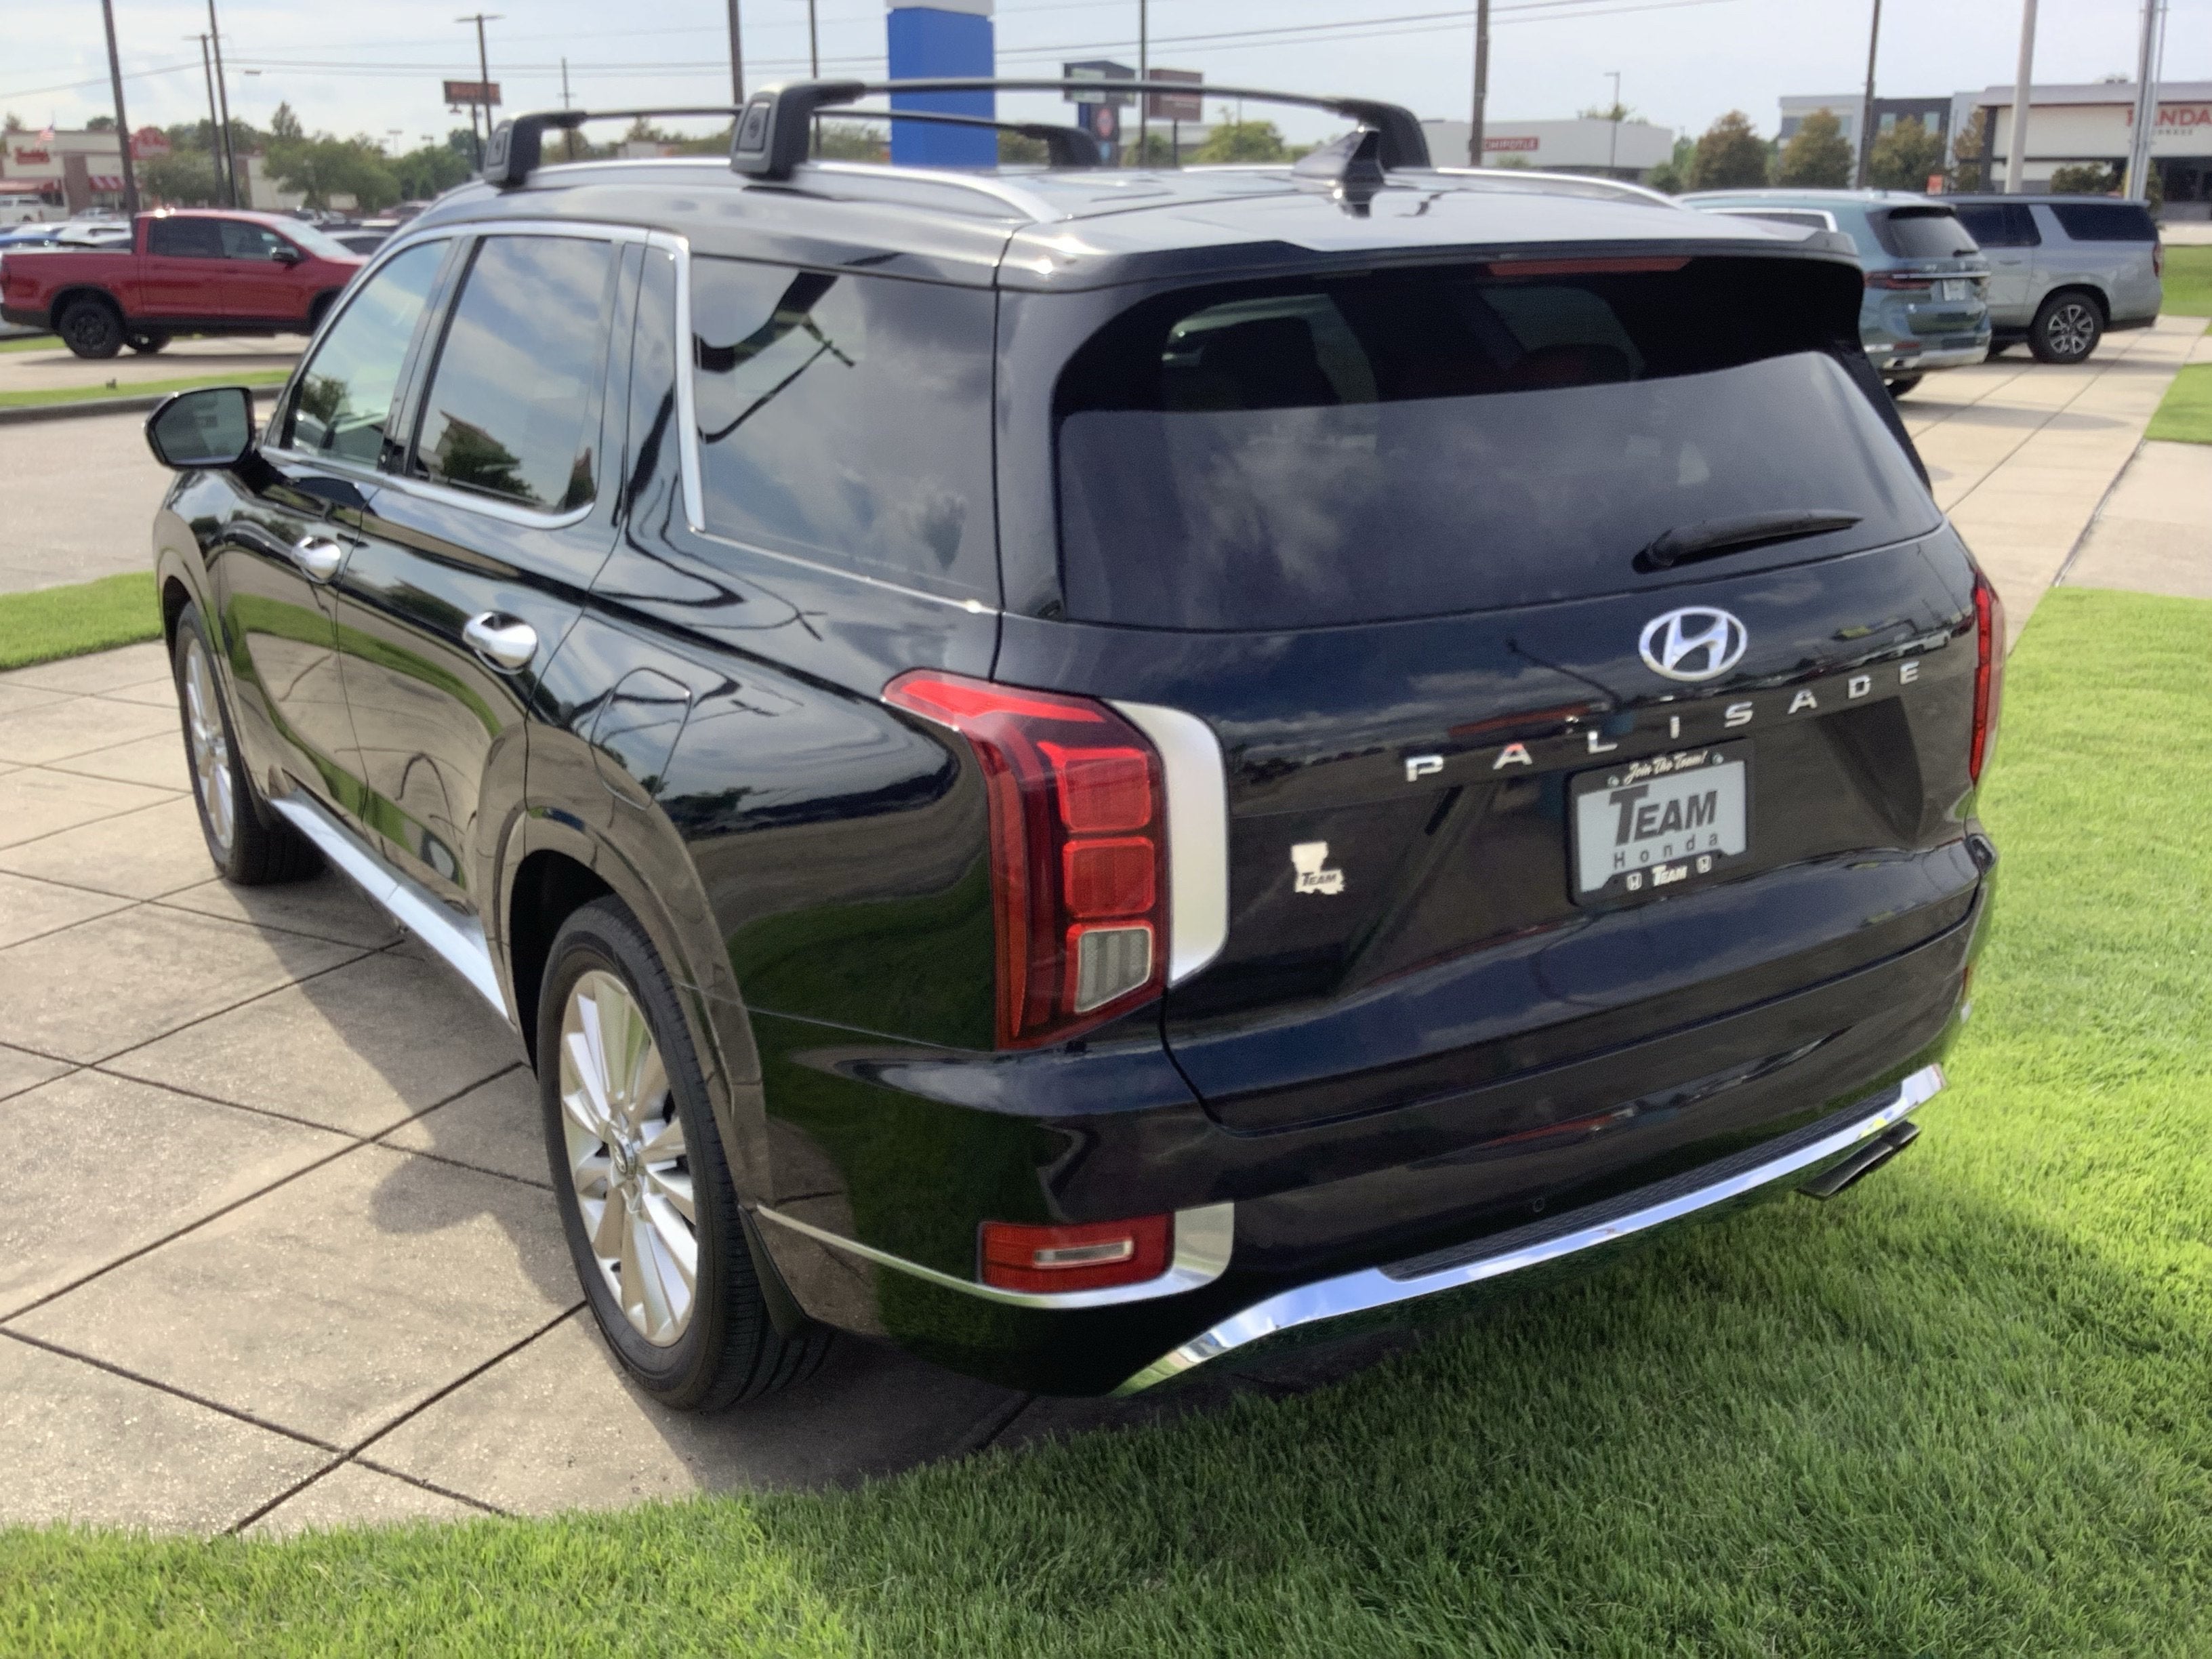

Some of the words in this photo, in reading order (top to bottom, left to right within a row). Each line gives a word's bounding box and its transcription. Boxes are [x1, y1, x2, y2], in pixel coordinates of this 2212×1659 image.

[2125, 108, 2212, 127] NDA
[1406, 661, 1920, 781] PALISADE
[1624, 762, 1652, 785] Join
[1652, 756, 1673, 775] The
[1609, 783, 1718, 847] TEAM
[1614, 833, 1718, 869] Honda
